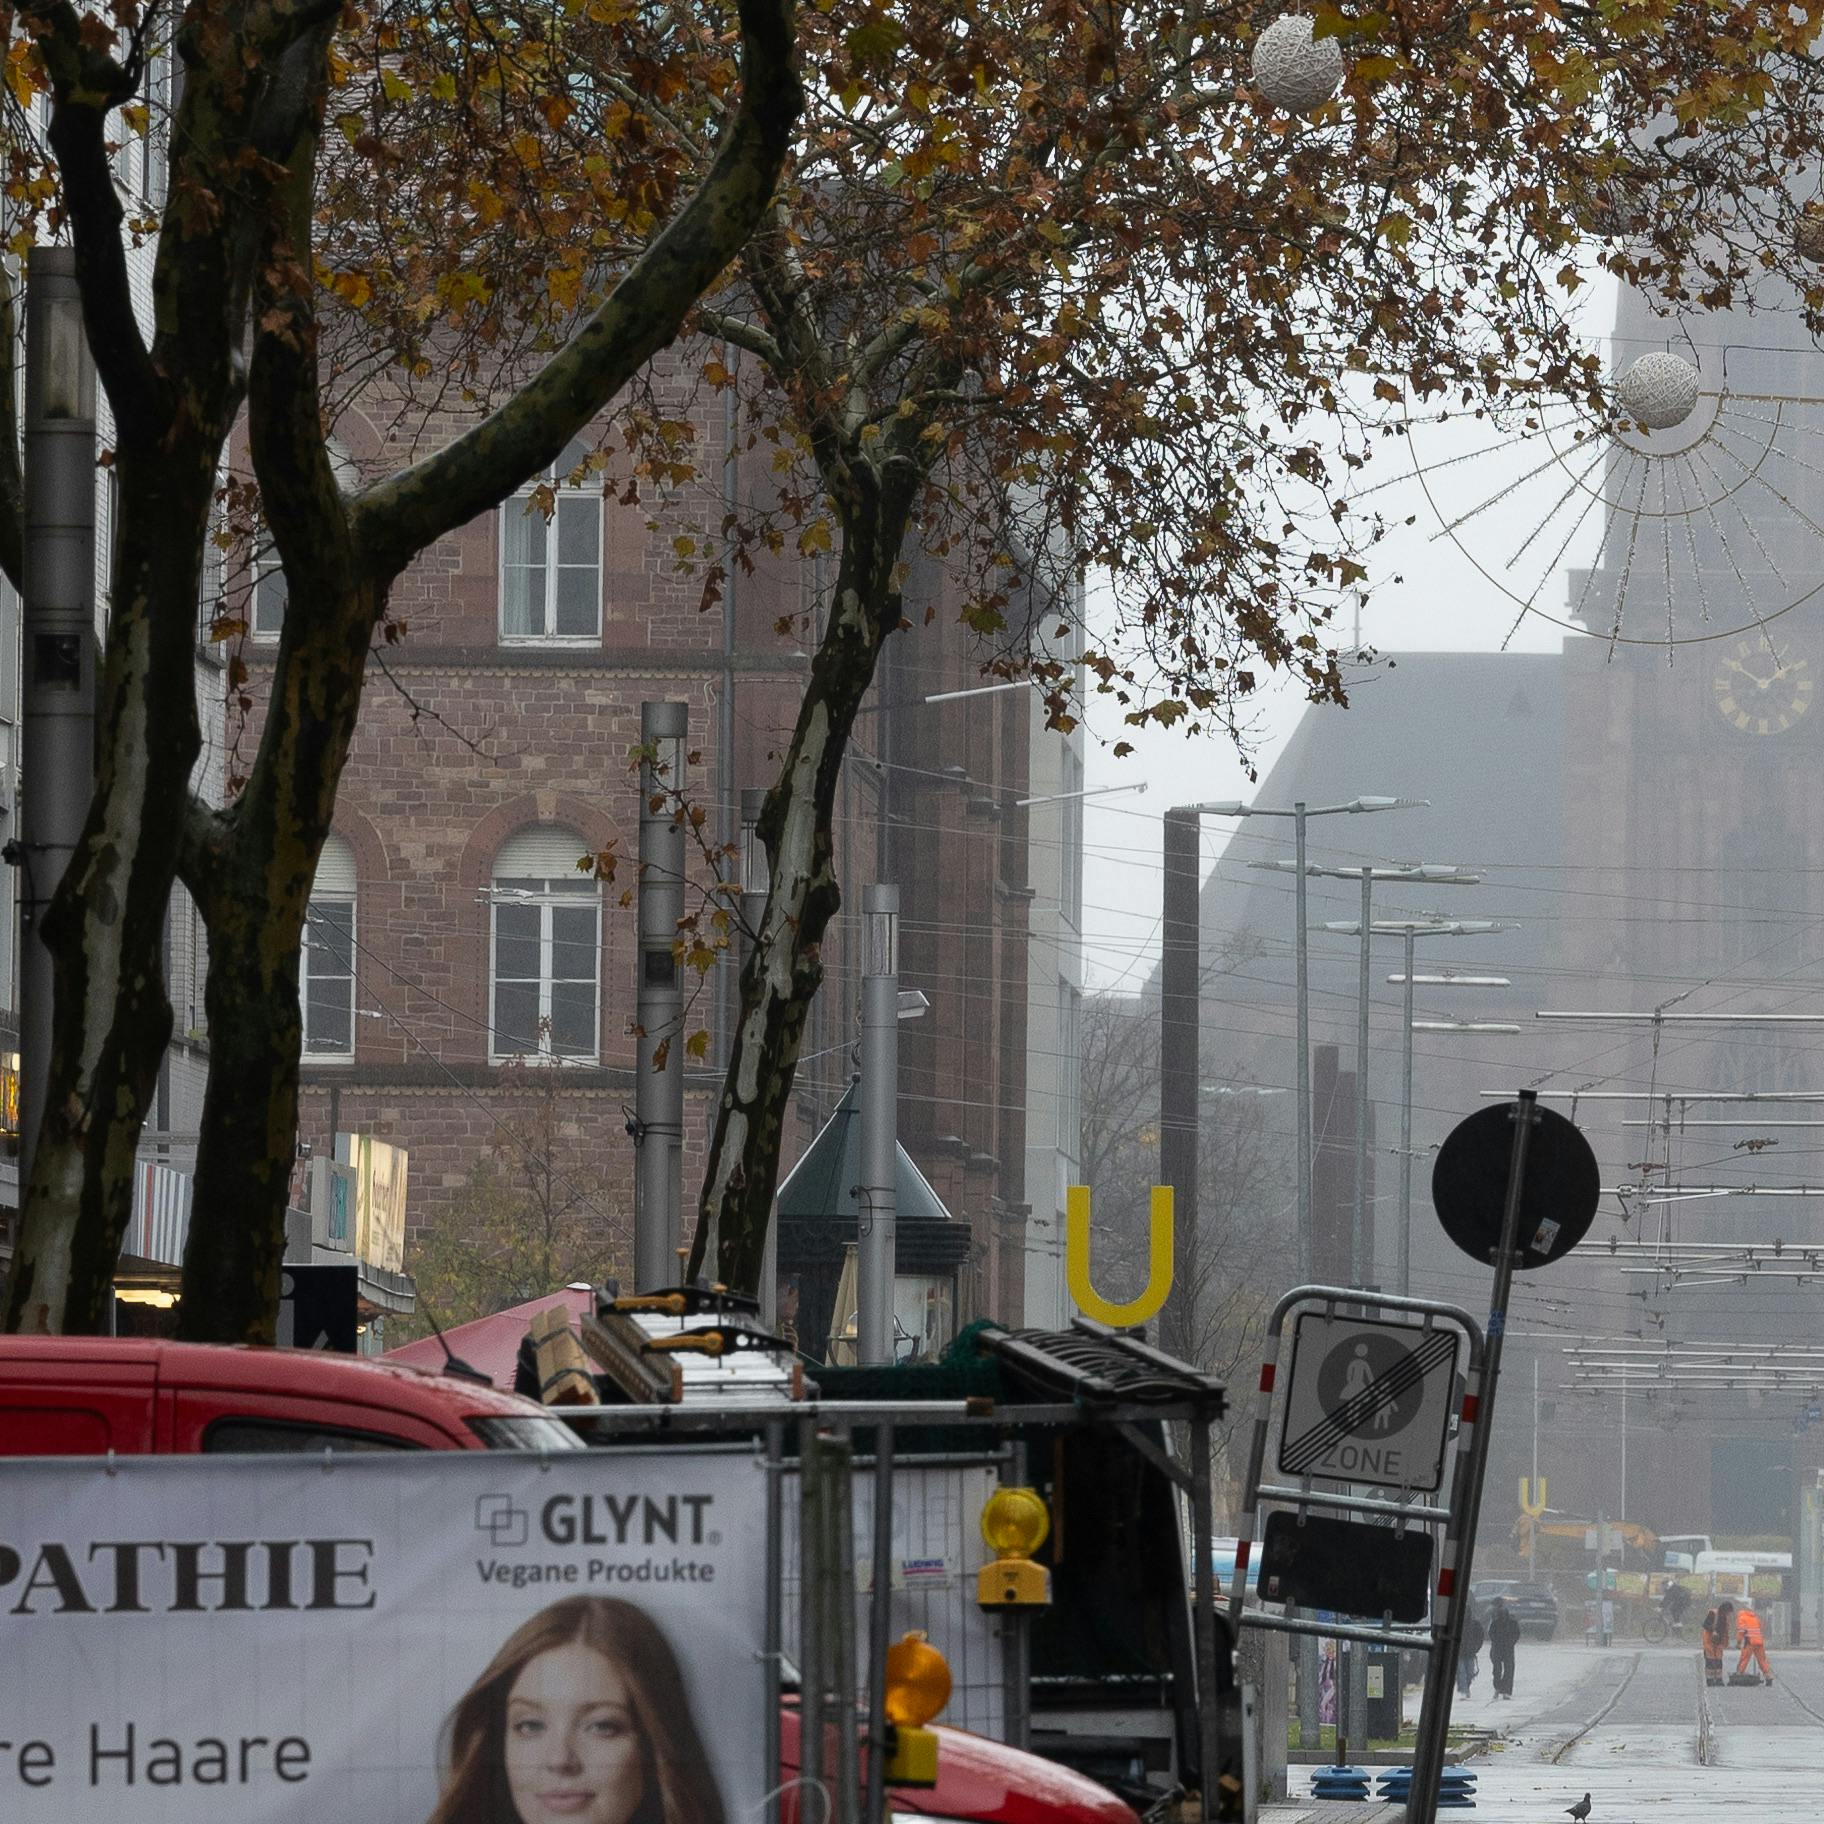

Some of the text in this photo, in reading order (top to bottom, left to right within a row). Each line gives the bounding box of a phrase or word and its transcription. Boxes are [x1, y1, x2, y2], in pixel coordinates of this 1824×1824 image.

[1066, 1185, 1175, 1328] U
[1320, 1443, 1403, 1476] ZONE
[475, 1558, 715, 1589] Vegane Produkte
[90, 1722, 312, 1786] Haare
